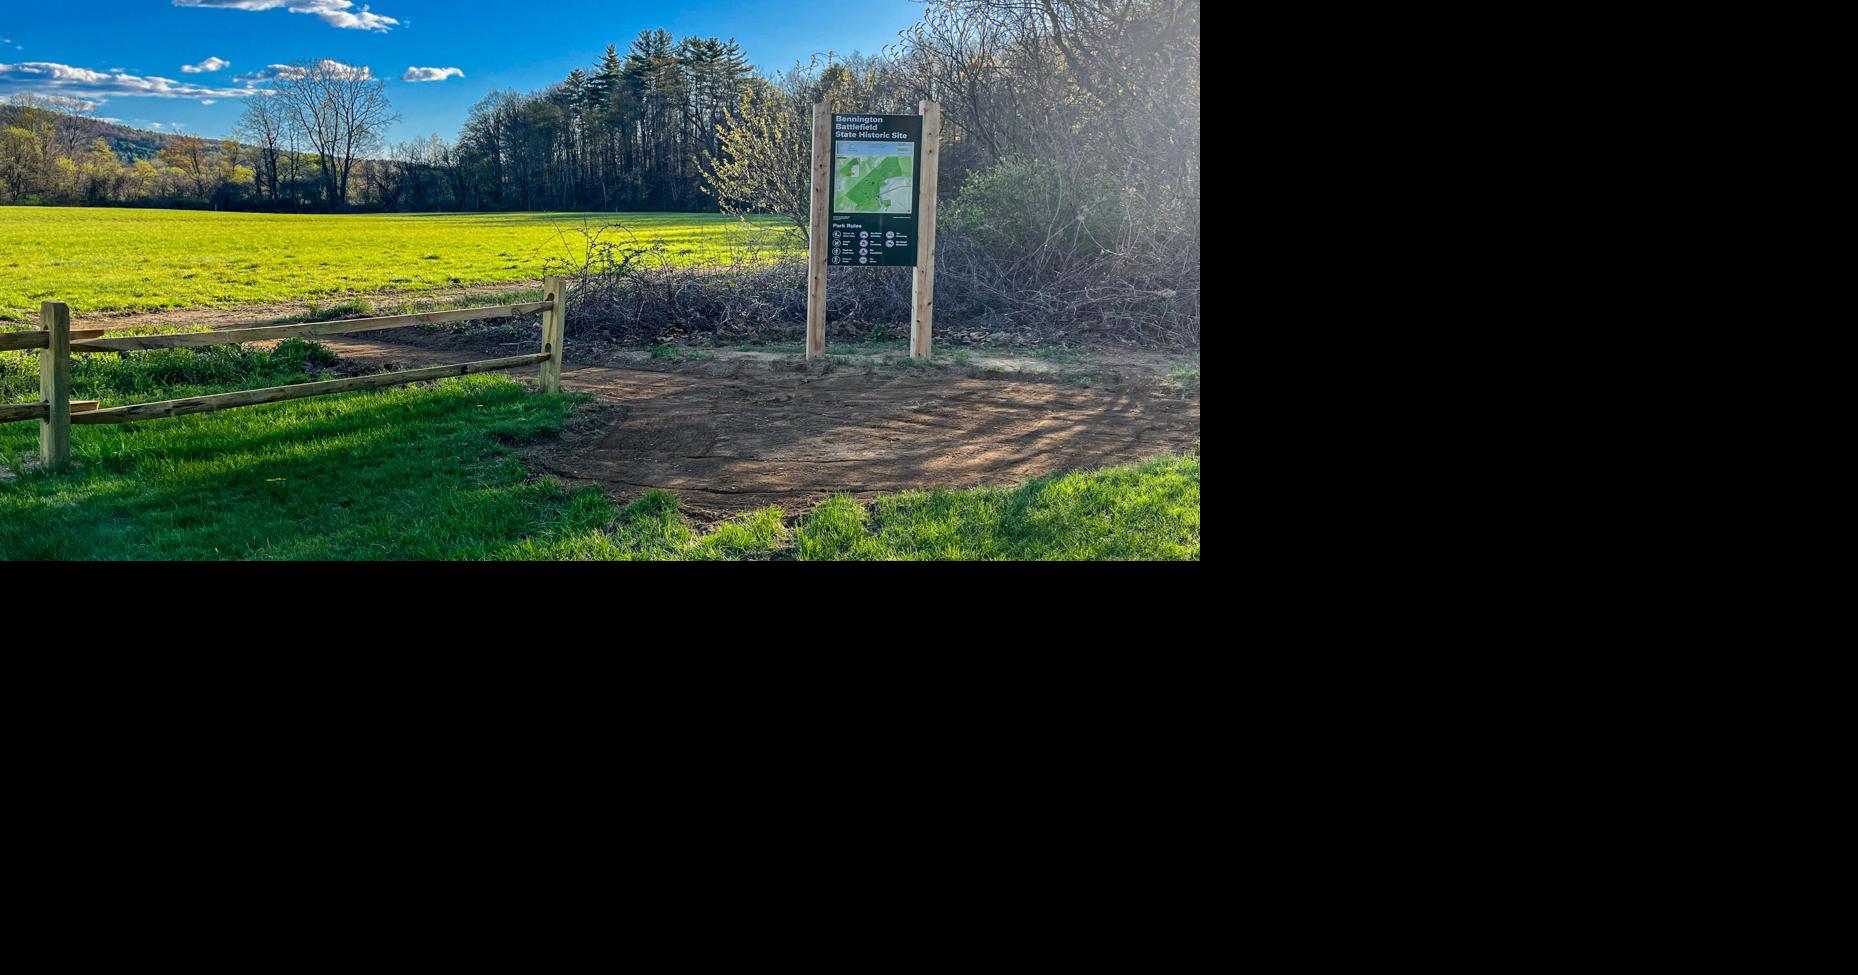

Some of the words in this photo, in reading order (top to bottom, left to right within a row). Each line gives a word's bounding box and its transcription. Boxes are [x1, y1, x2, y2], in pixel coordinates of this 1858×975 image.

[835, 115, 883, 124] Bennington
[835, 123, 878, 131] Battlefield
[859, 131, 890, 139] Historic
